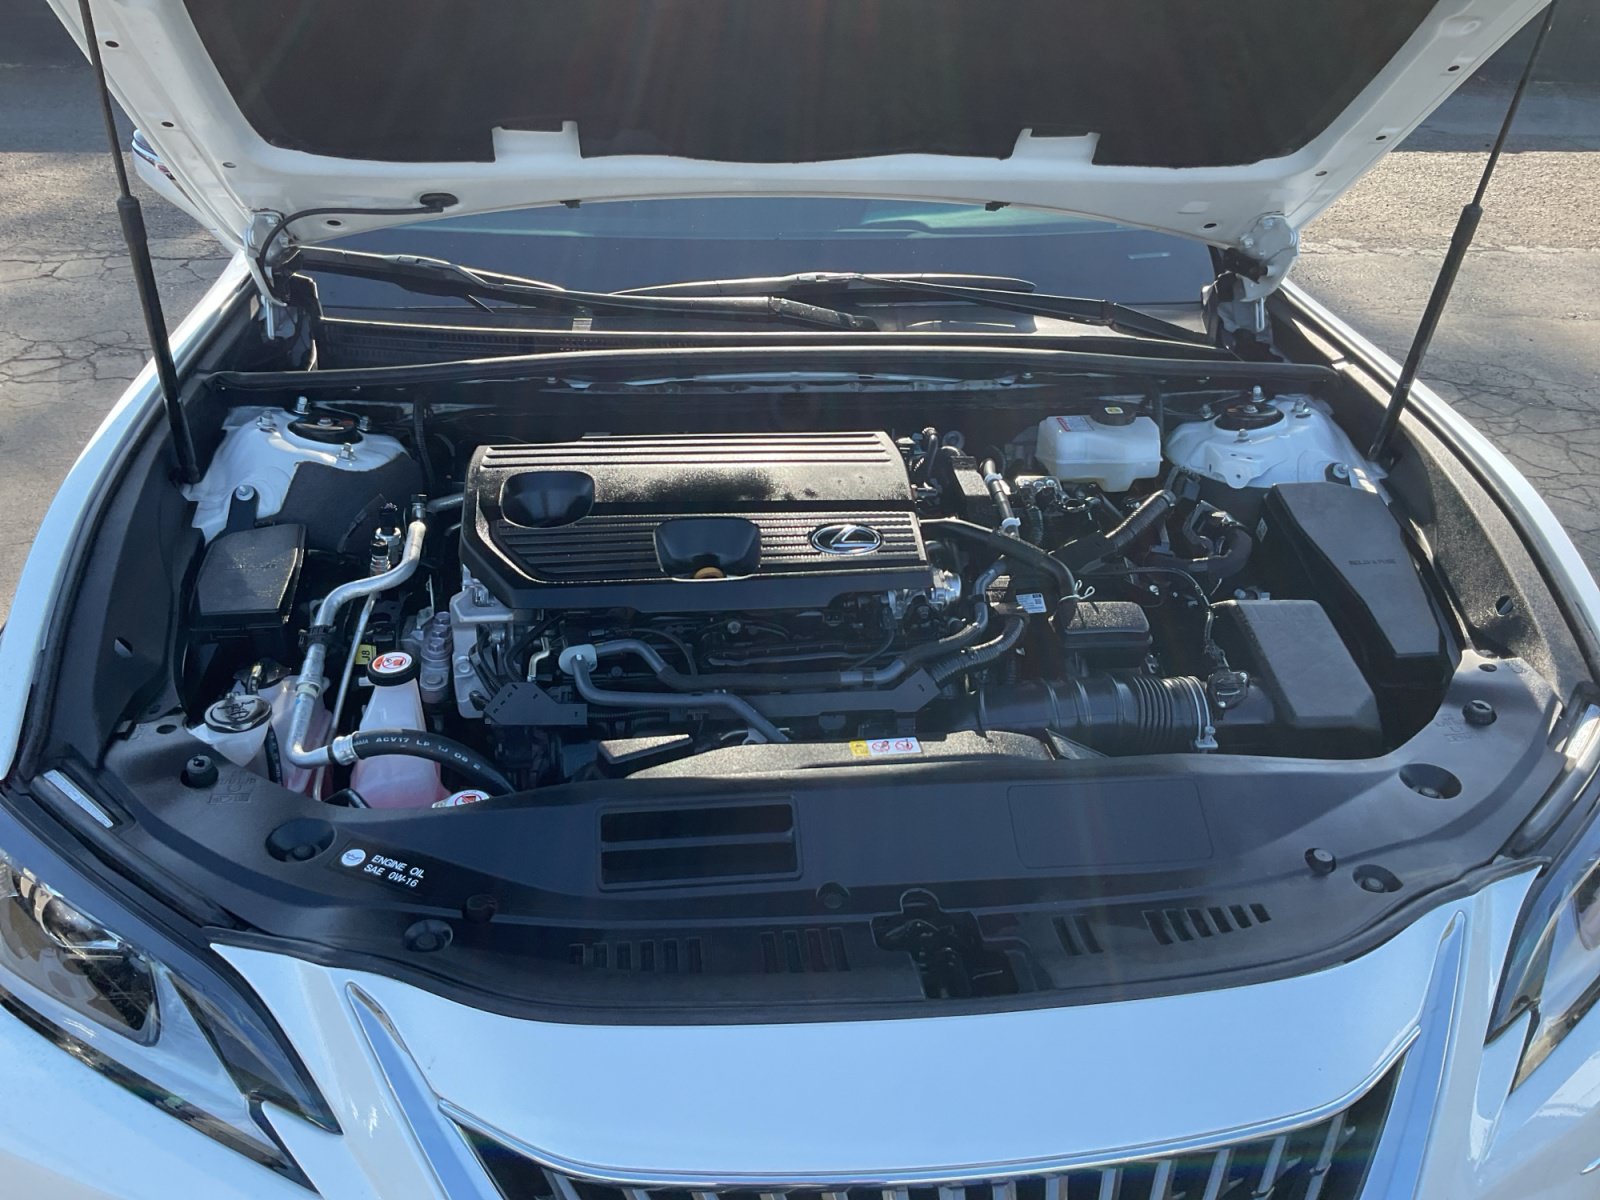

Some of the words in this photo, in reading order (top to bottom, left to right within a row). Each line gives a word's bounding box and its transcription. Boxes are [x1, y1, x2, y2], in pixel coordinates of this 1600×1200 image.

[363, 863, 386, 876] SAE
[387, 871, 419, 887] 0W-16
[371, 854, 407, 871] ENGINE
[409, 867, 425, 879] OIL
